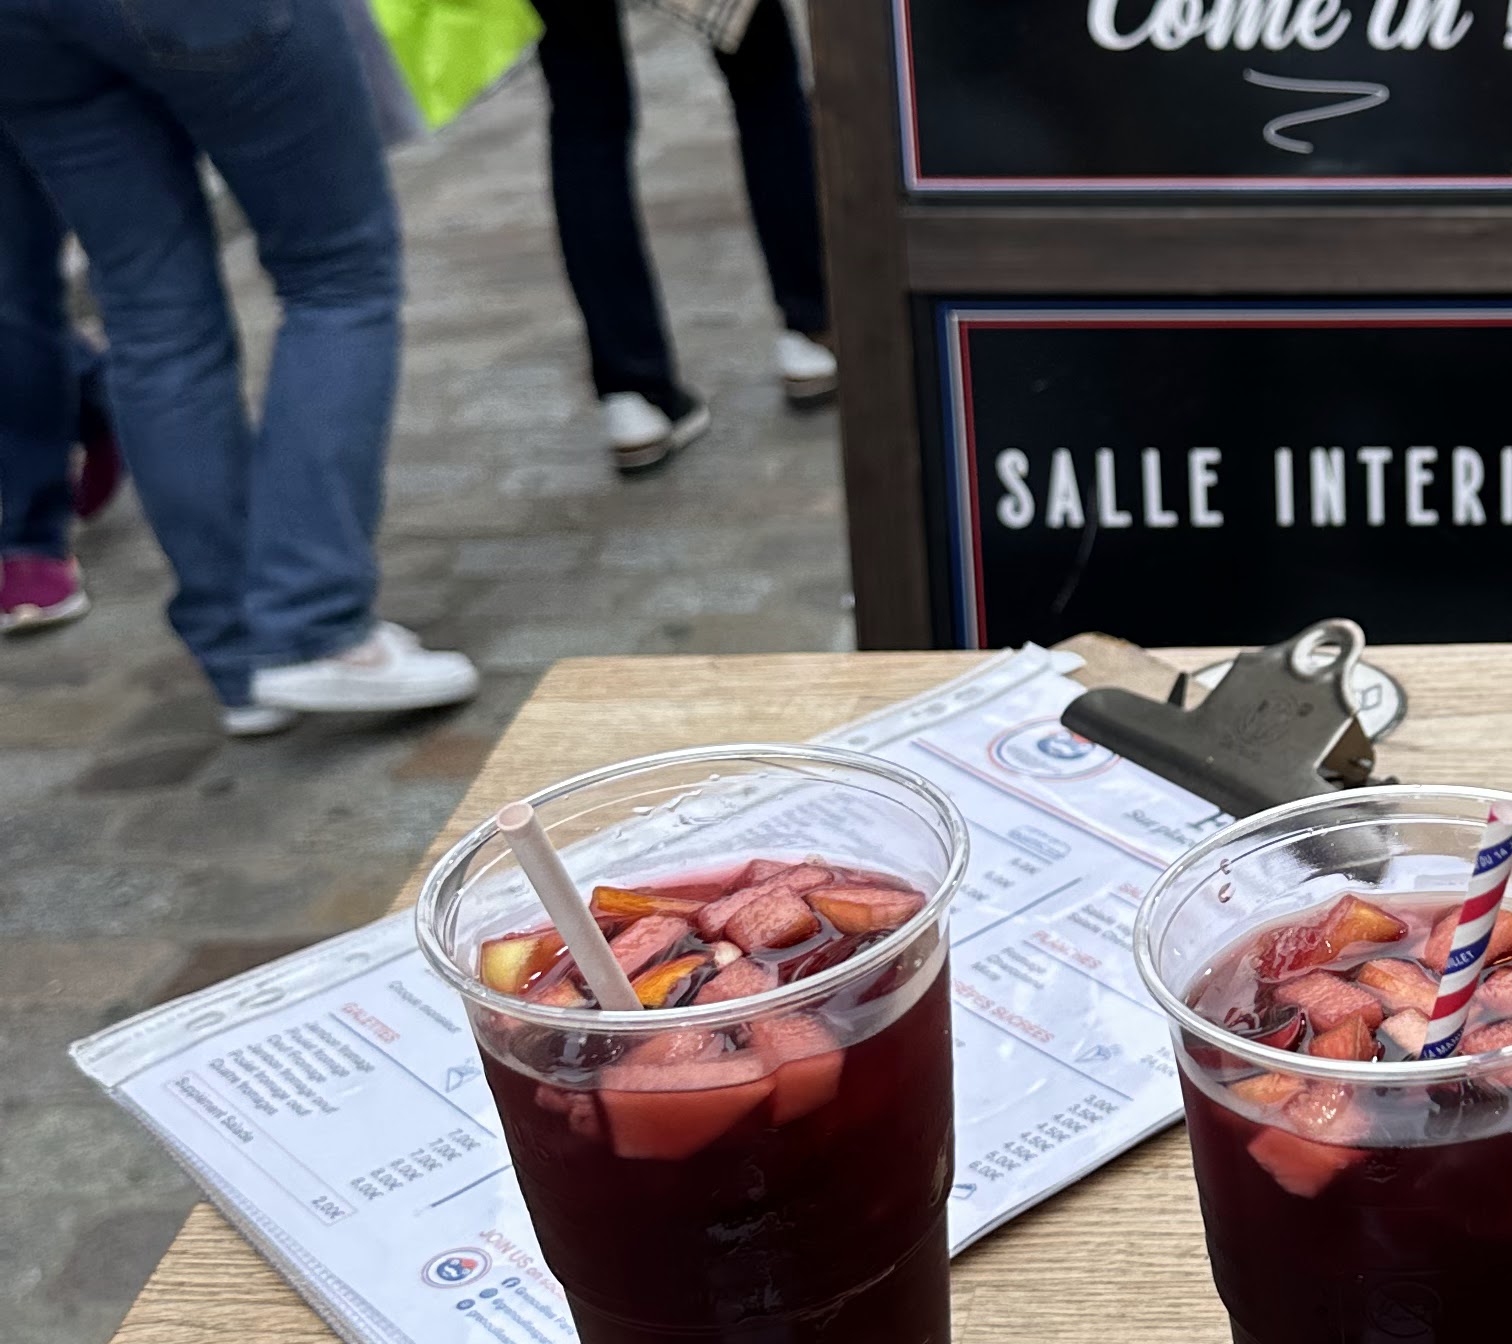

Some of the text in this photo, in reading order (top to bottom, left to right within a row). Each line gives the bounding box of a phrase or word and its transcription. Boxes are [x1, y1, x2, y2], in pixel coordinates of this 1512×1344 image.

[995, 446, 1225, 530] SALLE
[479, 1229, 518, 1254] JOIN
[509, 1250, 534, 1269] US
